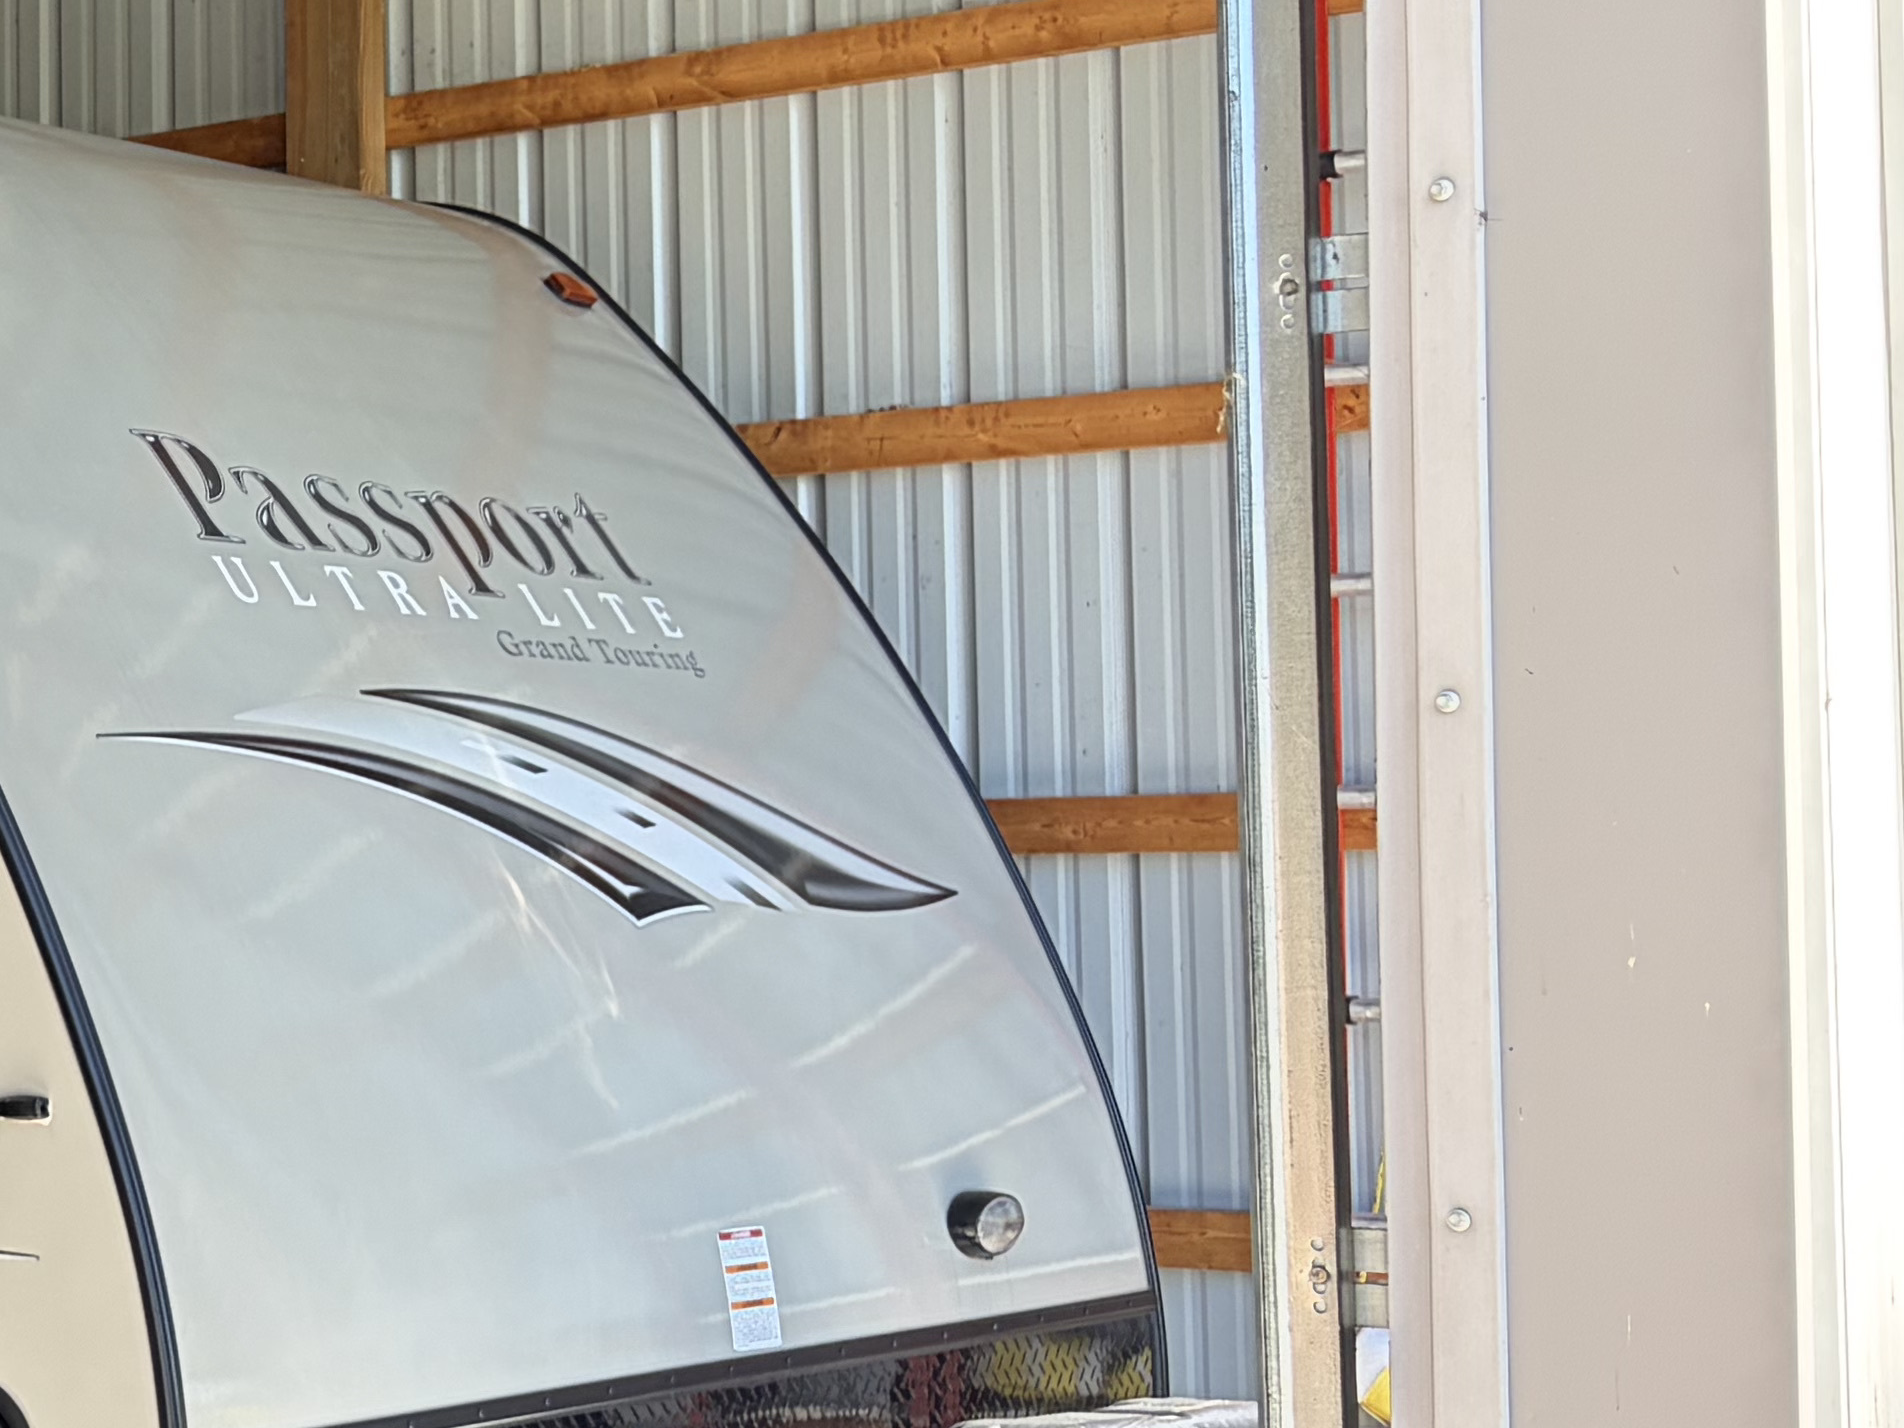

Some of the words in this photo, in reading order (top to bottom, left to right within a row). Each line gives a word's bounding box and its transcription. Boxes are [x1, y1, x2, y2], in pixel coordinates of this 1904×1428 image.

[128, 428, 652, 597] Passport
[211, 555, 479, 621] ULTRA
[517, 582, 685, 639] LITE
[497, 631, 588, 665] Grand
[594, 636, 706, 677] Touring
